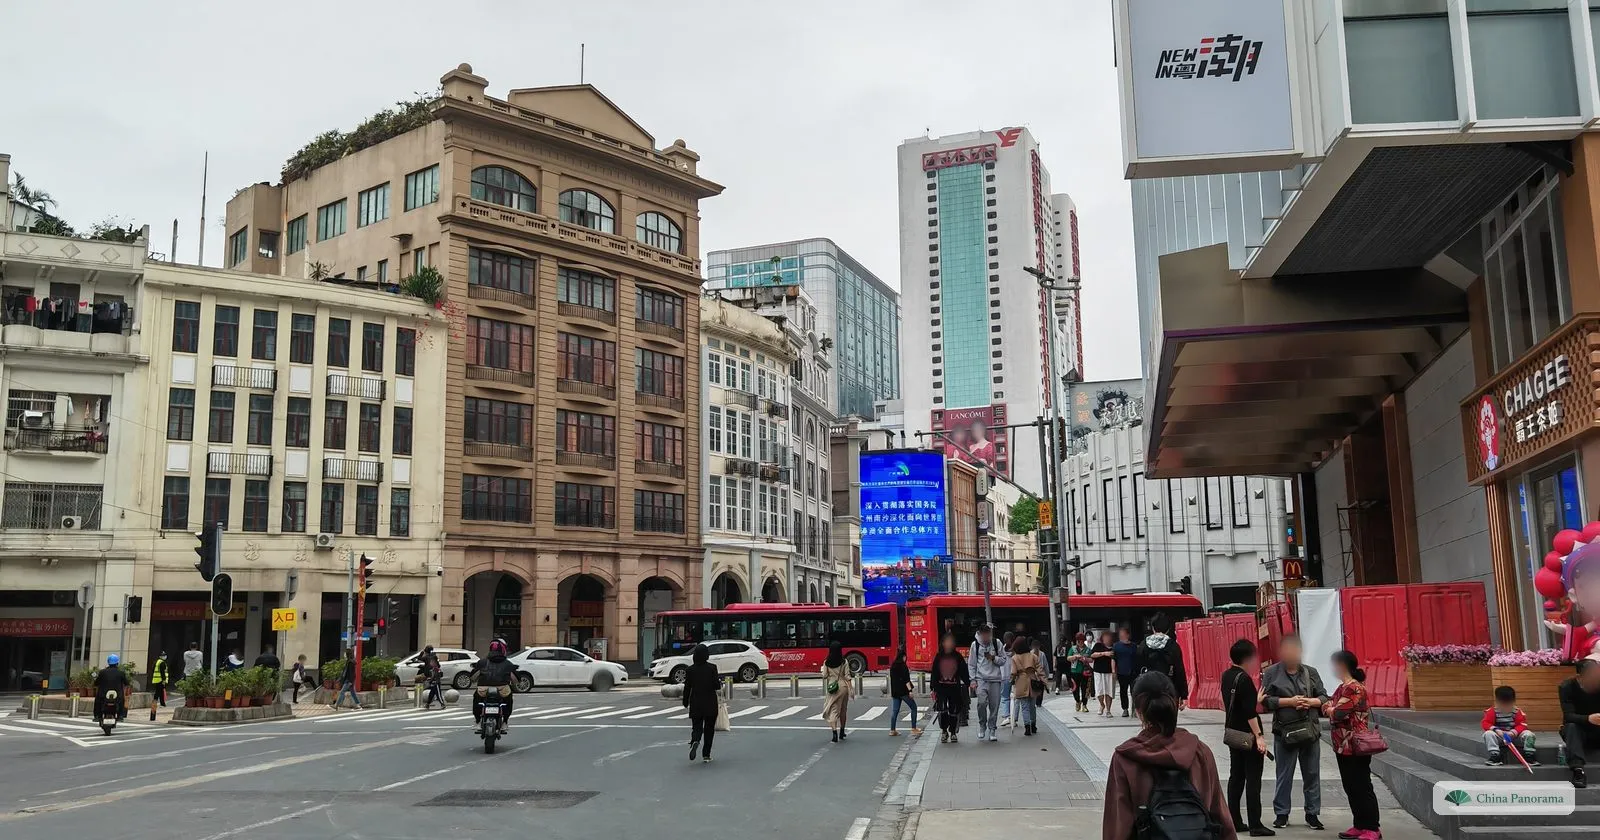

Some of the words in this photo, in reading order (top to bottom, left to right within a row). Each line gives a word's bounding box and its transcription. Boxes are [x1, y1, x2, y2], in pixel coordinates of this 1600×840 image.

[1160, 48, 1198, 63] NEW
[1196, 33, 1263, 82] 潮
[1505, 354, 1568, 418] CHAGEE
[950, 411, 987, 420] LANCÔME
[1515, 400, 1560, 443] 霸王茶姬
[274, 612, 294, 622] 入口
